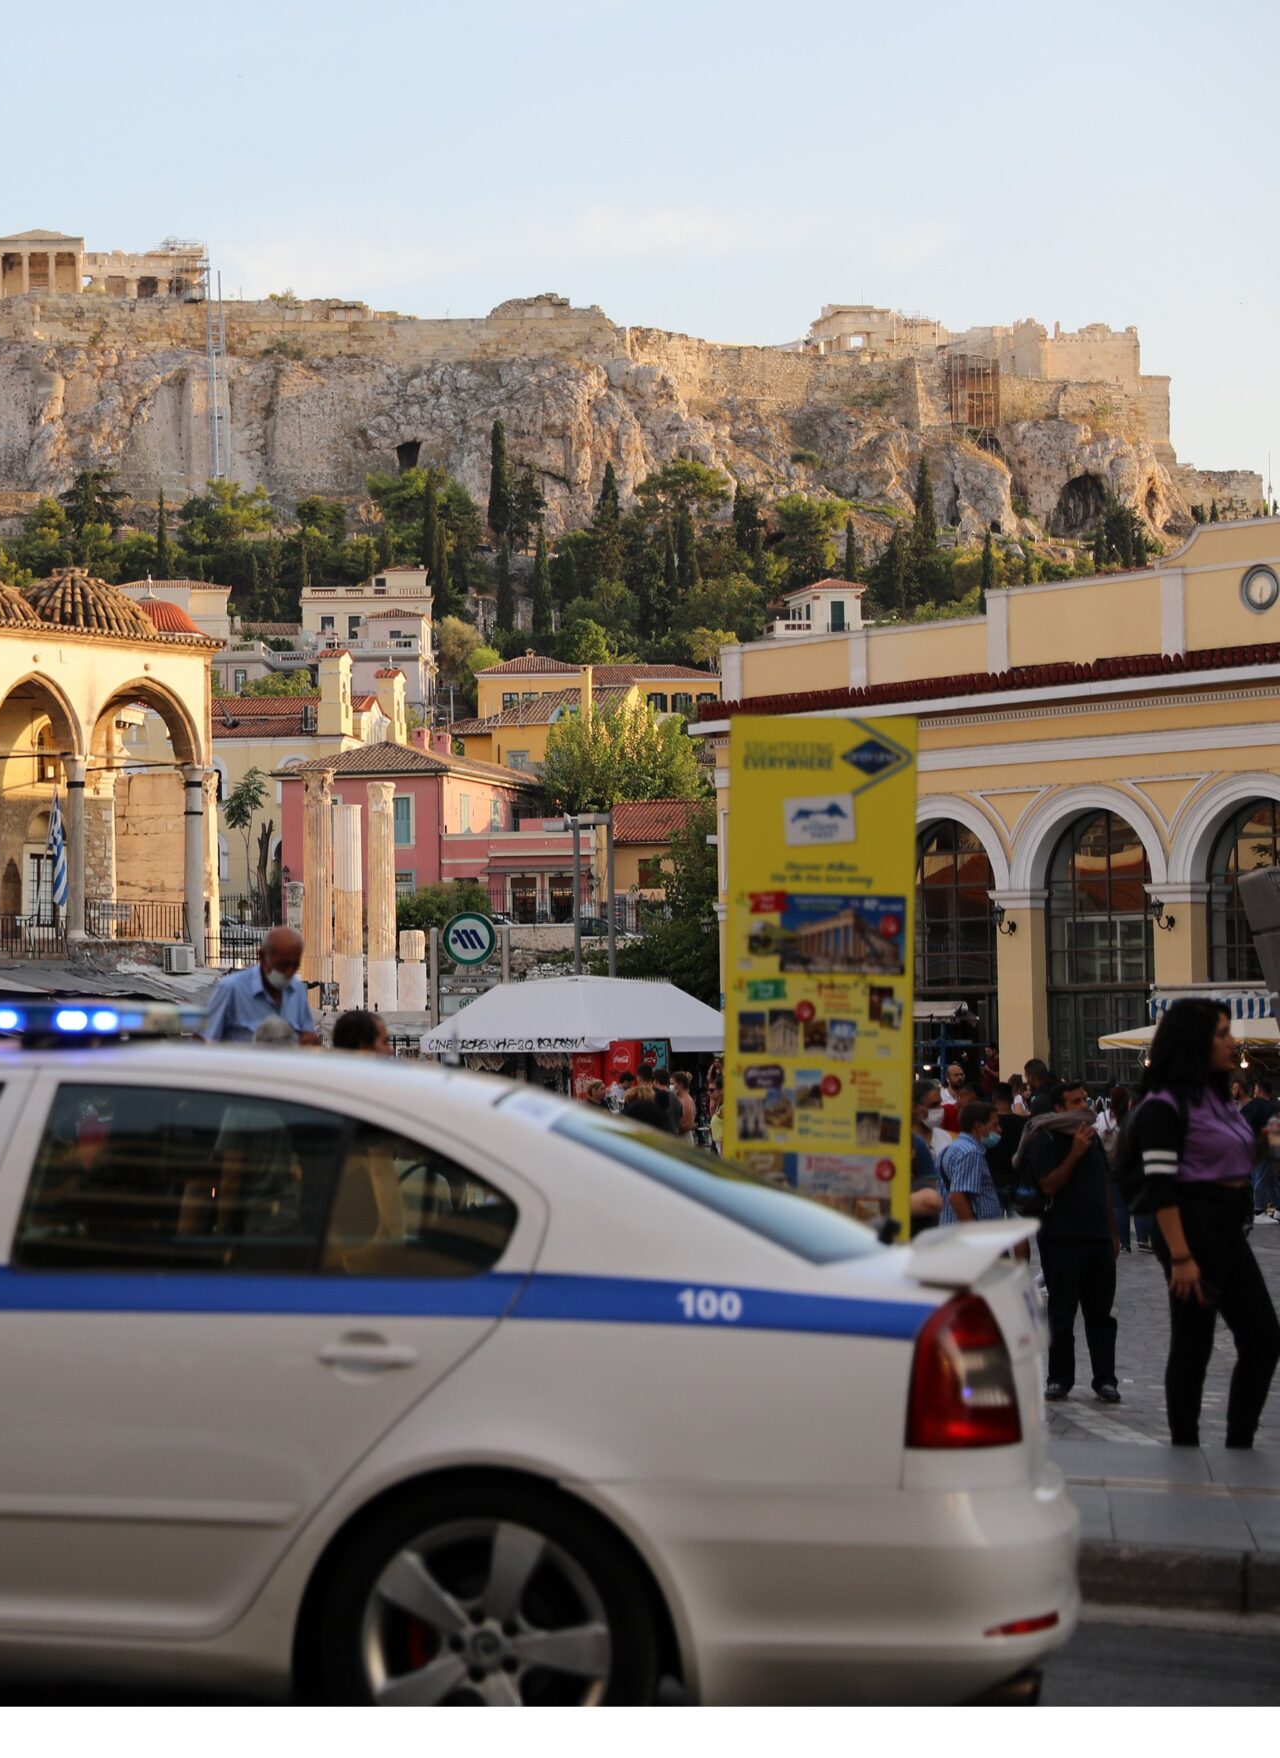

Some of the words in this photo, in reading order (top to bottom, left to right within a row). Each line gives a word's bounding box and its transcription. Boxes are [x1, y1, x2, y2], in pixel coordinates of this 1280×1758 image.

[745, 741, 833, 754] SIGHTSEEING
[744, 755, 833, 770] EVERYWHERE
[677, 1289, 743, 1321] 100
